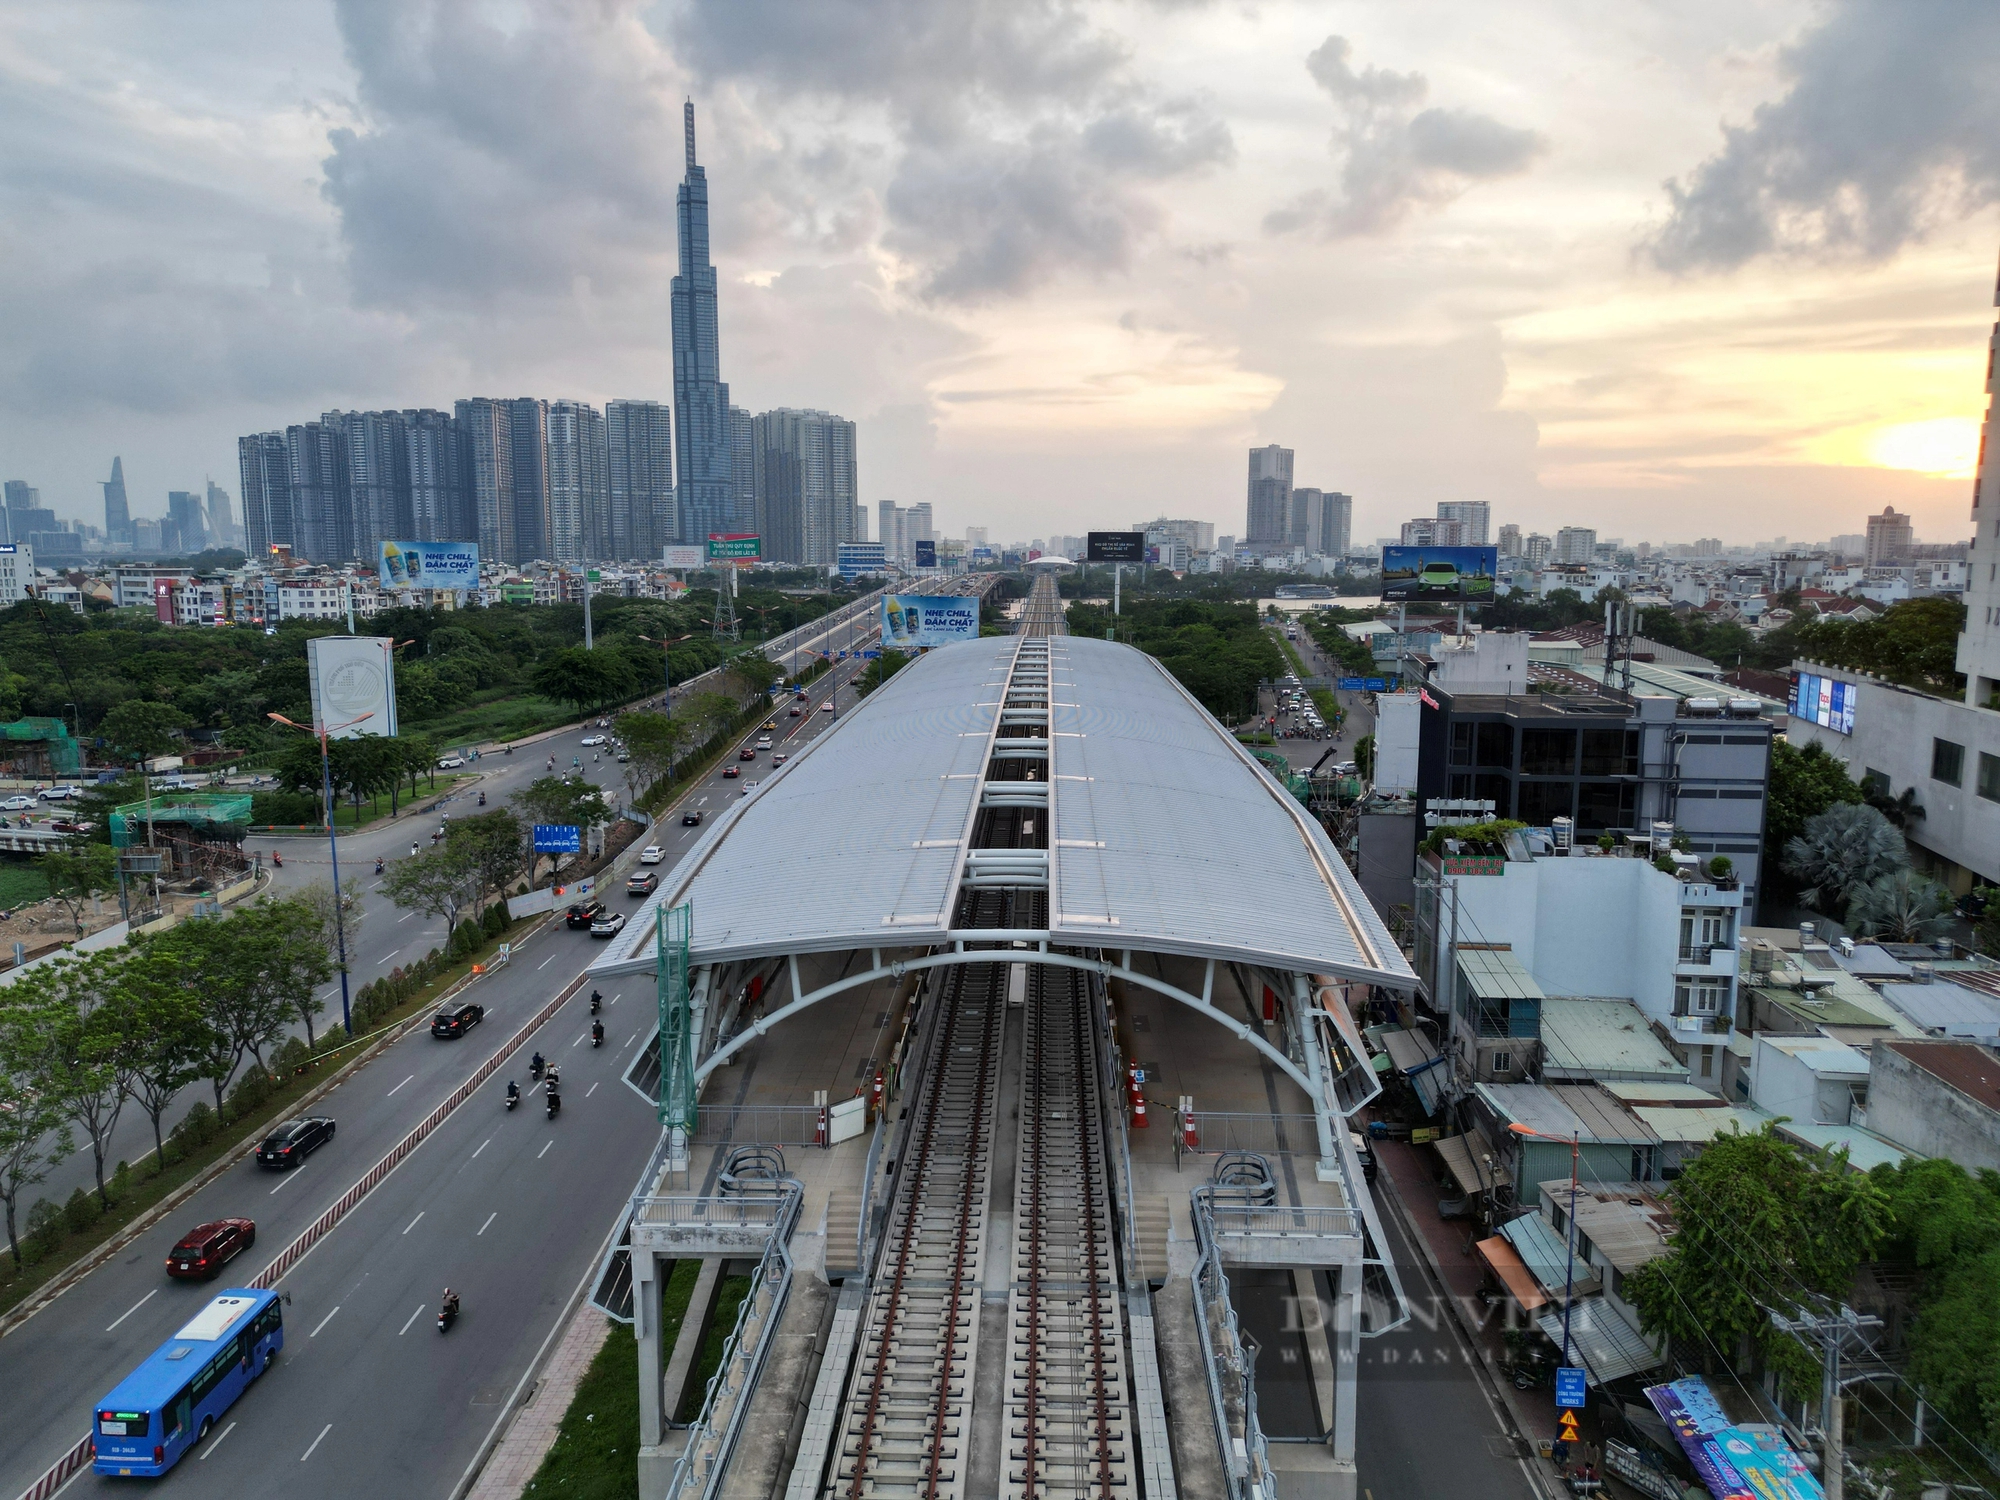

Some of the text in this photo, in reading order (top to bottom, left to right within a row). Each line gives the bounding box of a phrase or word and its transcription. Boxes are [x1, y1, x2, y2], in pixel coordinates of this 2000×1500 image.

[425, 553, 445, 561] NHẸ
[425, 560, 475, 569] ĐẬM CHẤT
[925, 610, 945, 618] NHẸ
[925, 618, 974, 627] ĐẬM CHẤT
